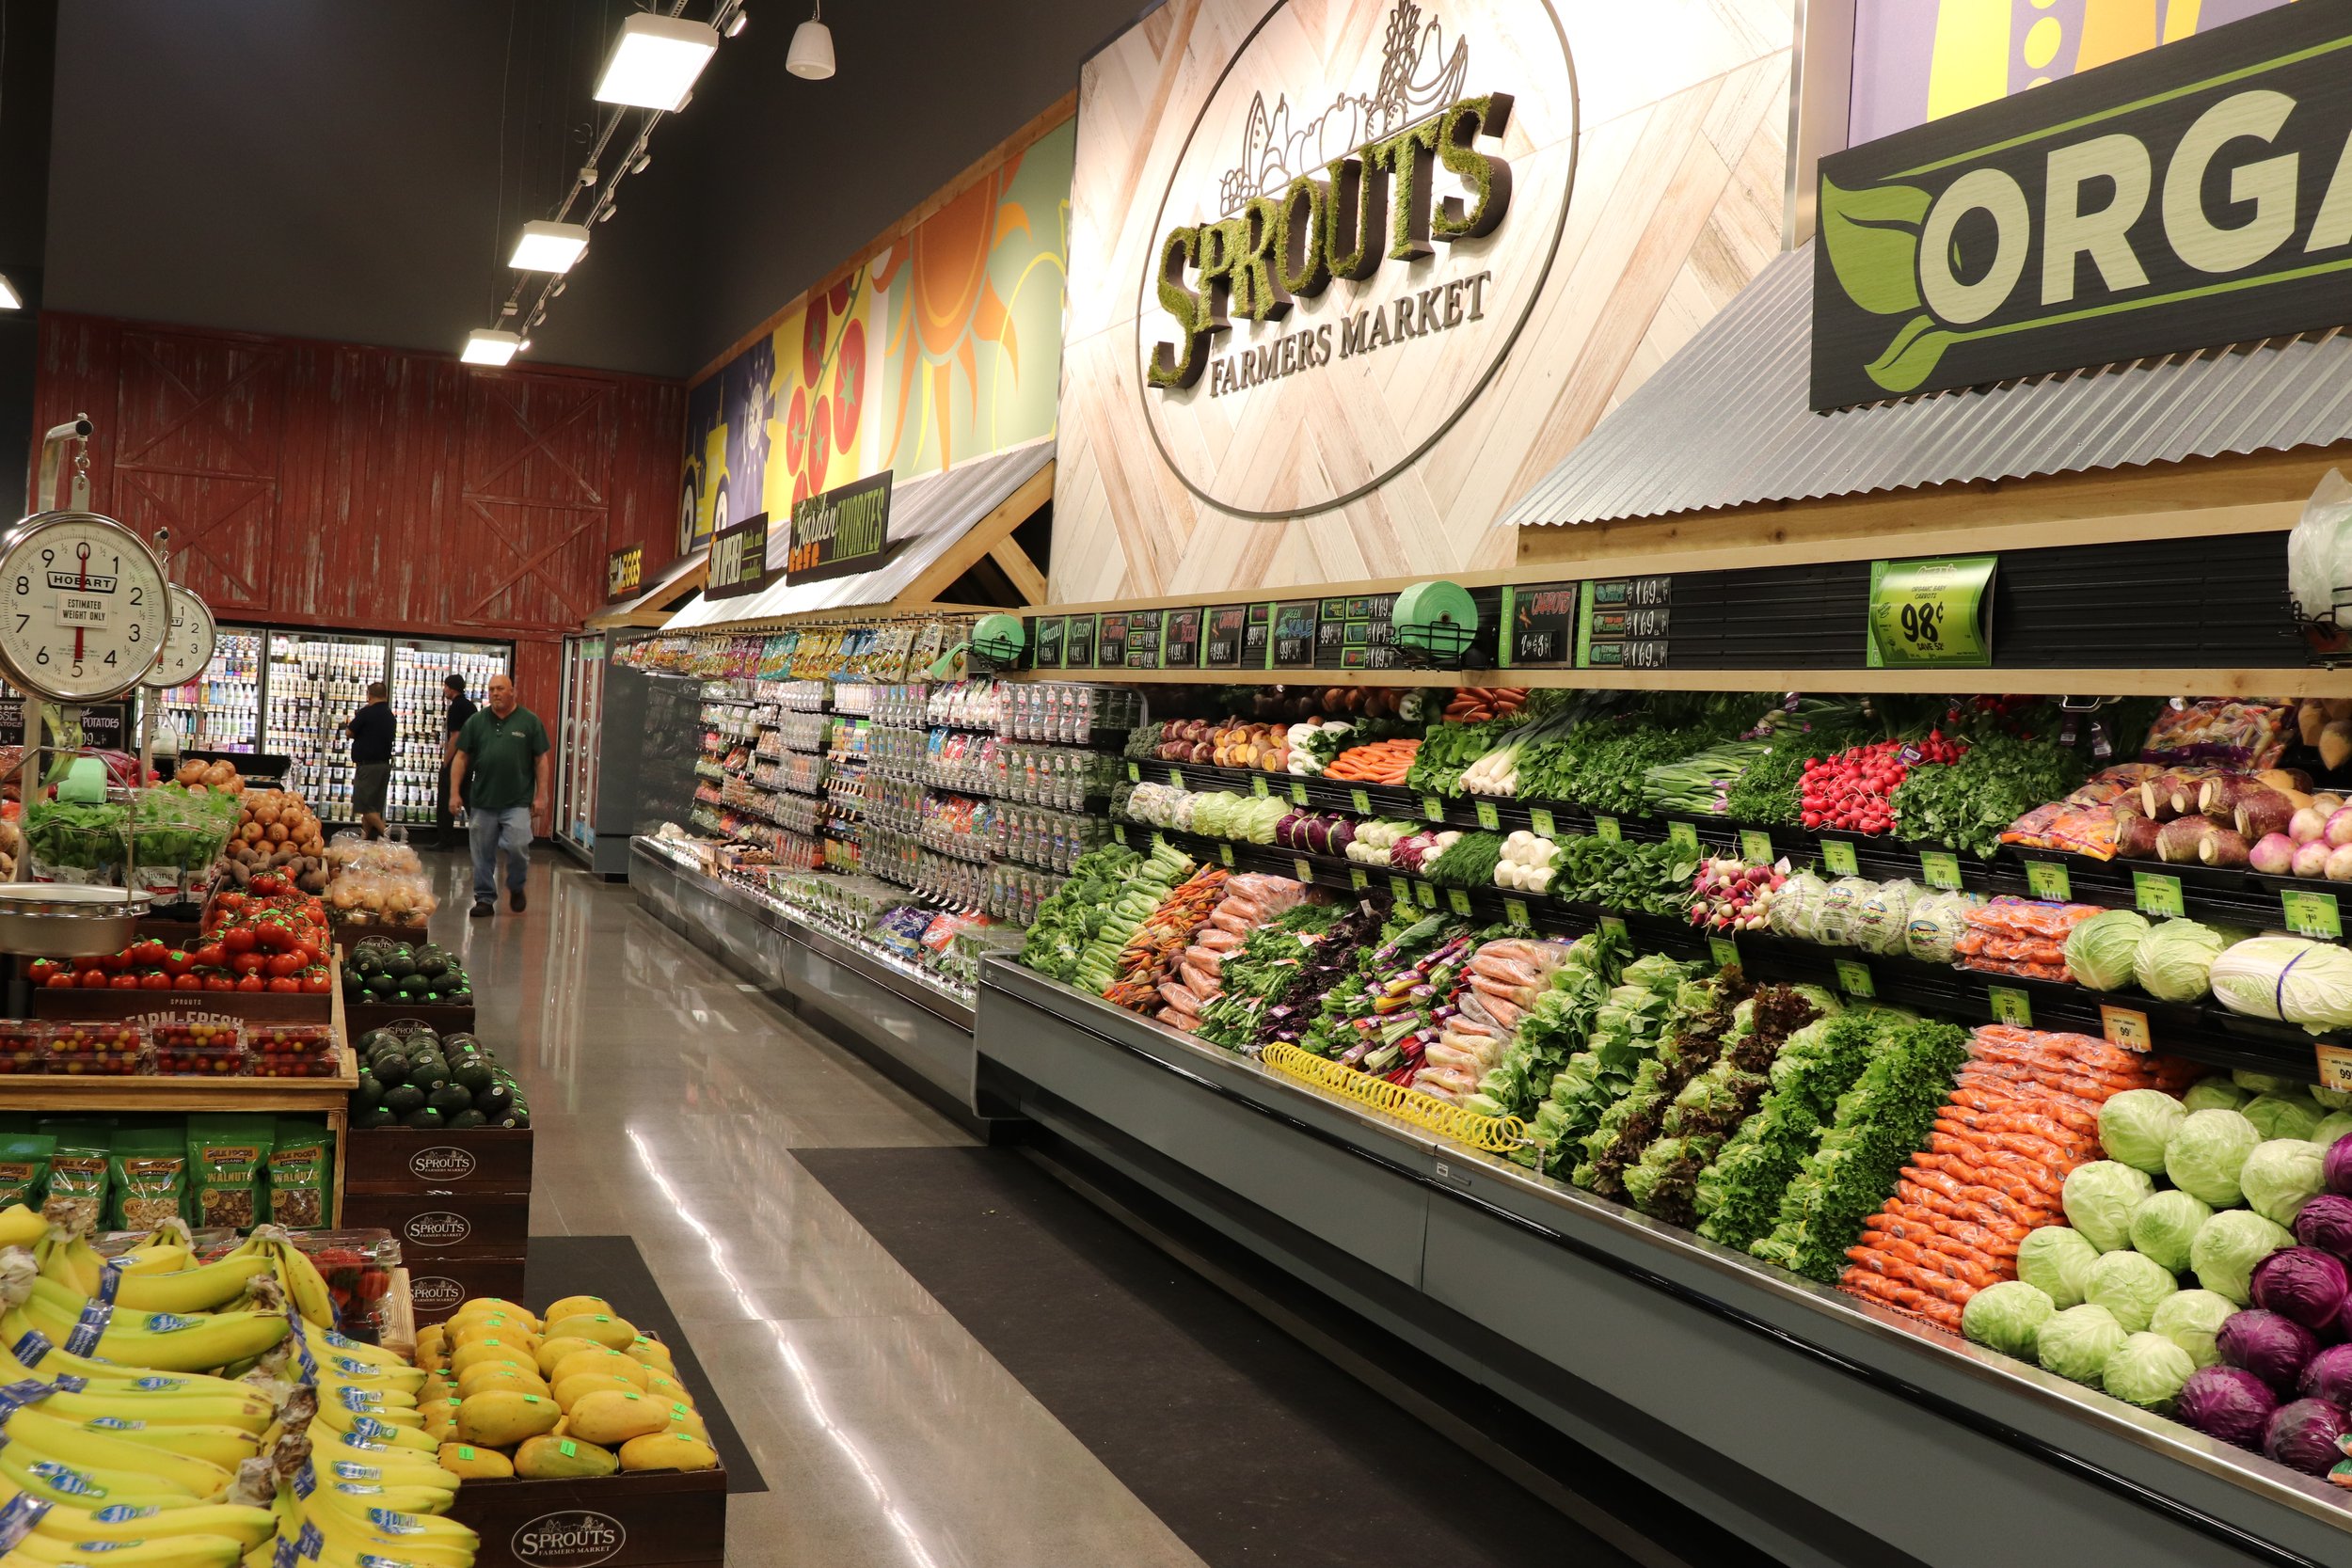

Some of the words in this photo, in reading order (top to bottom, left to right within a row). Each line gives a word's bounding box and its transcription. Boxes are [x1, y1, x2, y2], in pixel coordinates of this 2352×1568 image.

[1148, 92, 1514, 389] SPROUTS
[1210, 323, 1332, 398] FARMERS
[1340, 271, 1491, 358] MARKET
[794, 494, 837, 557] Garden
[833, 487, 885, 559] FAVORITES
[41, 548, 55, 568] 9
[76, 542, 90, 560] 0
[112, 556, 119, 574] 1
[622, 549, 641, 587] EGGS
[16, 576, 29, 595] 8
[54, 576, 111, 588] HOBART
[130, 587, 143, 606] 2
[1532, 591, 1571, 616] CARROTS
[68, 599, 102, 610] ESTIMATED
[181, 606, 184, 616] 1
[63, 610, 87, 620] WEIGHT
[89, 611, 105, 621] ONLY
[1283, 607, 1303, 619] GREEN
[16, 613, 30, 633] 7
[191, 623, 199, 633] 2
[1289, 619, 1314, 639] KALE
[1901, 602, 1945, 643] 98¢
[128, 624, 140, 642] 3
[191, 643, 199, 654] 3
[1916, 642, 1933, 651] SAVE
[36, 646, 49, 665] 6
[103, 650, 117, 669] 4
[176, 657, 183, 668] 4
[72, 659, 83, 678] 5
[156, 663, 164, 674] 5
[83, 717, 119, 728] POTATOES
[147, 870, 174, 881] living
[207, 1149, 227, 1158] BULK
[228, 1148, 254, 1158] FOODS
[293, 1148, 317, 1159] FOODS
[414, 1158, 469, 1172] SPROUTS
[207, 1172, 253, 1182] WALNUTS
[273, 1171, 319, 1182] WALNUTS
[202, 1194, 216, 1203] RAW
[124, 1202, 141, 1212] RAW
[409, 1223, 465, 1237] SPROUTS
[521, 1529, 615, 1555] SPROUTS
[576, 1545, 611, 1554] MARKET
